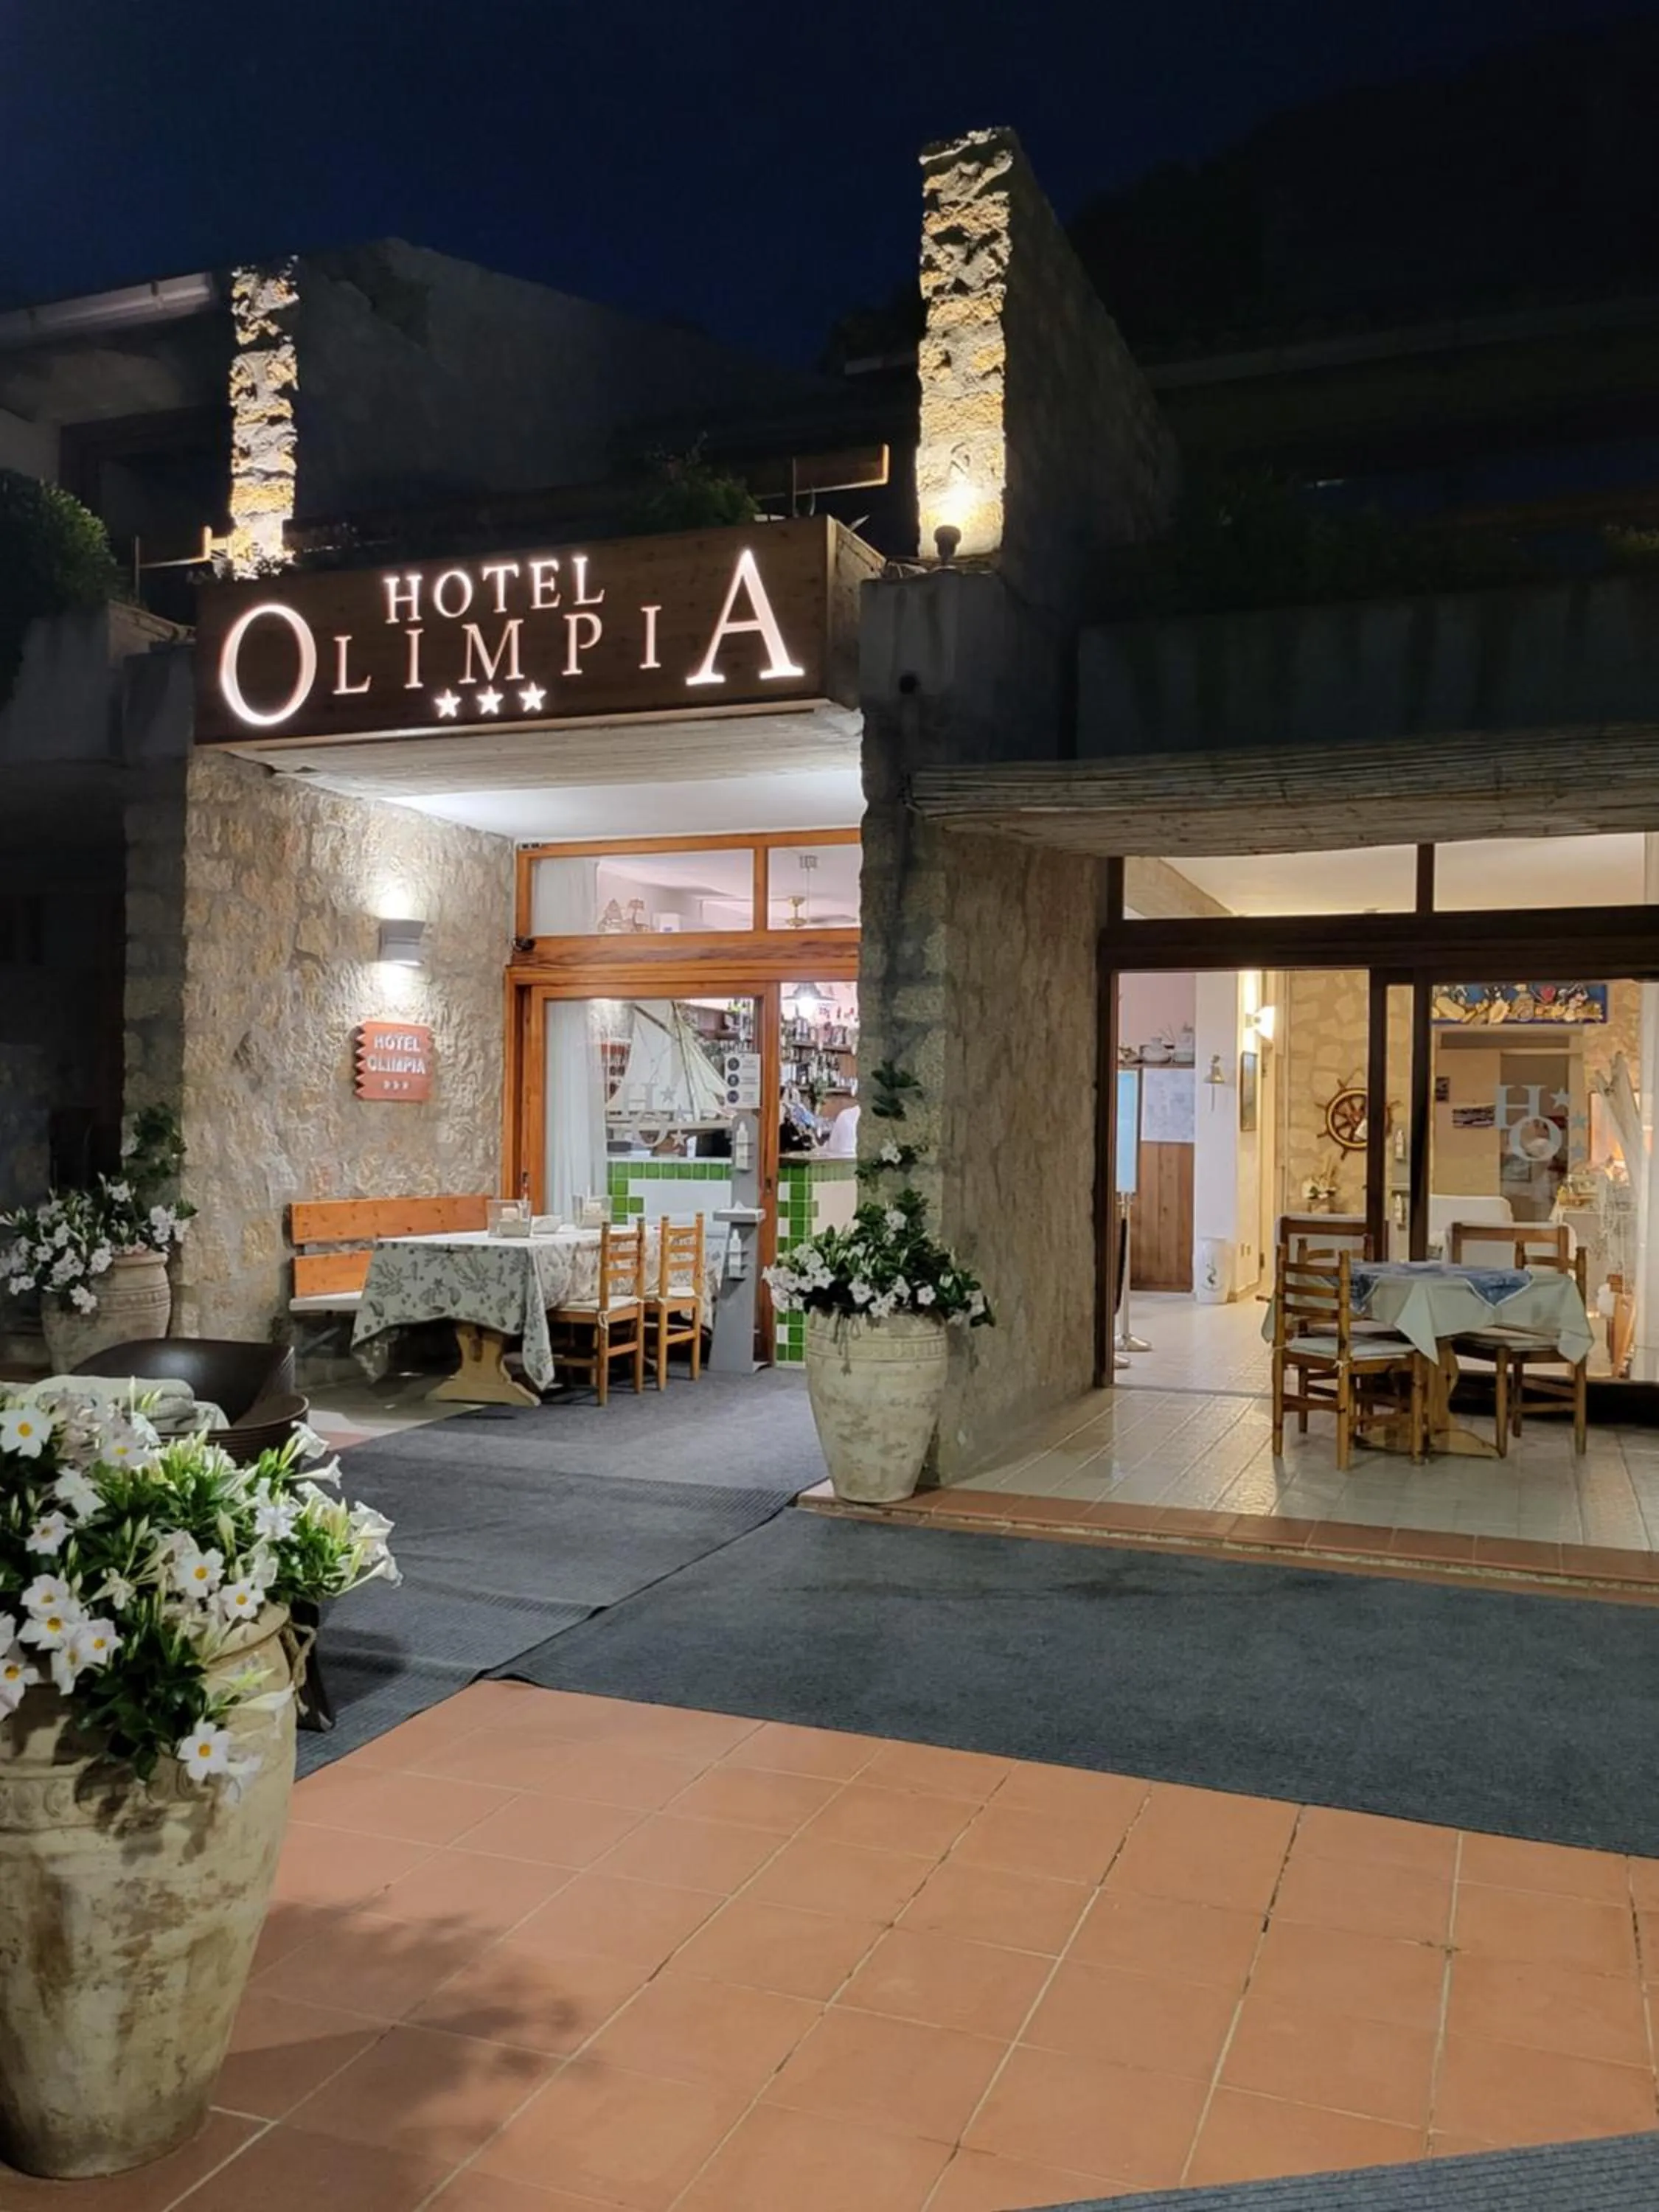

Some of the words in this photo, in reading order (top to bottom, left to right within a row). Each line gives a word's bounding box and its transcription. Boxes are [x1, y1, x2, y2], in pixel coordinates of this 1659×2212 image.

[383, 555, 605, 625] HOTEL
[219, 548, 806, 726] OLIMPIA
[375, 1034, 421, 1052] HOTEL
